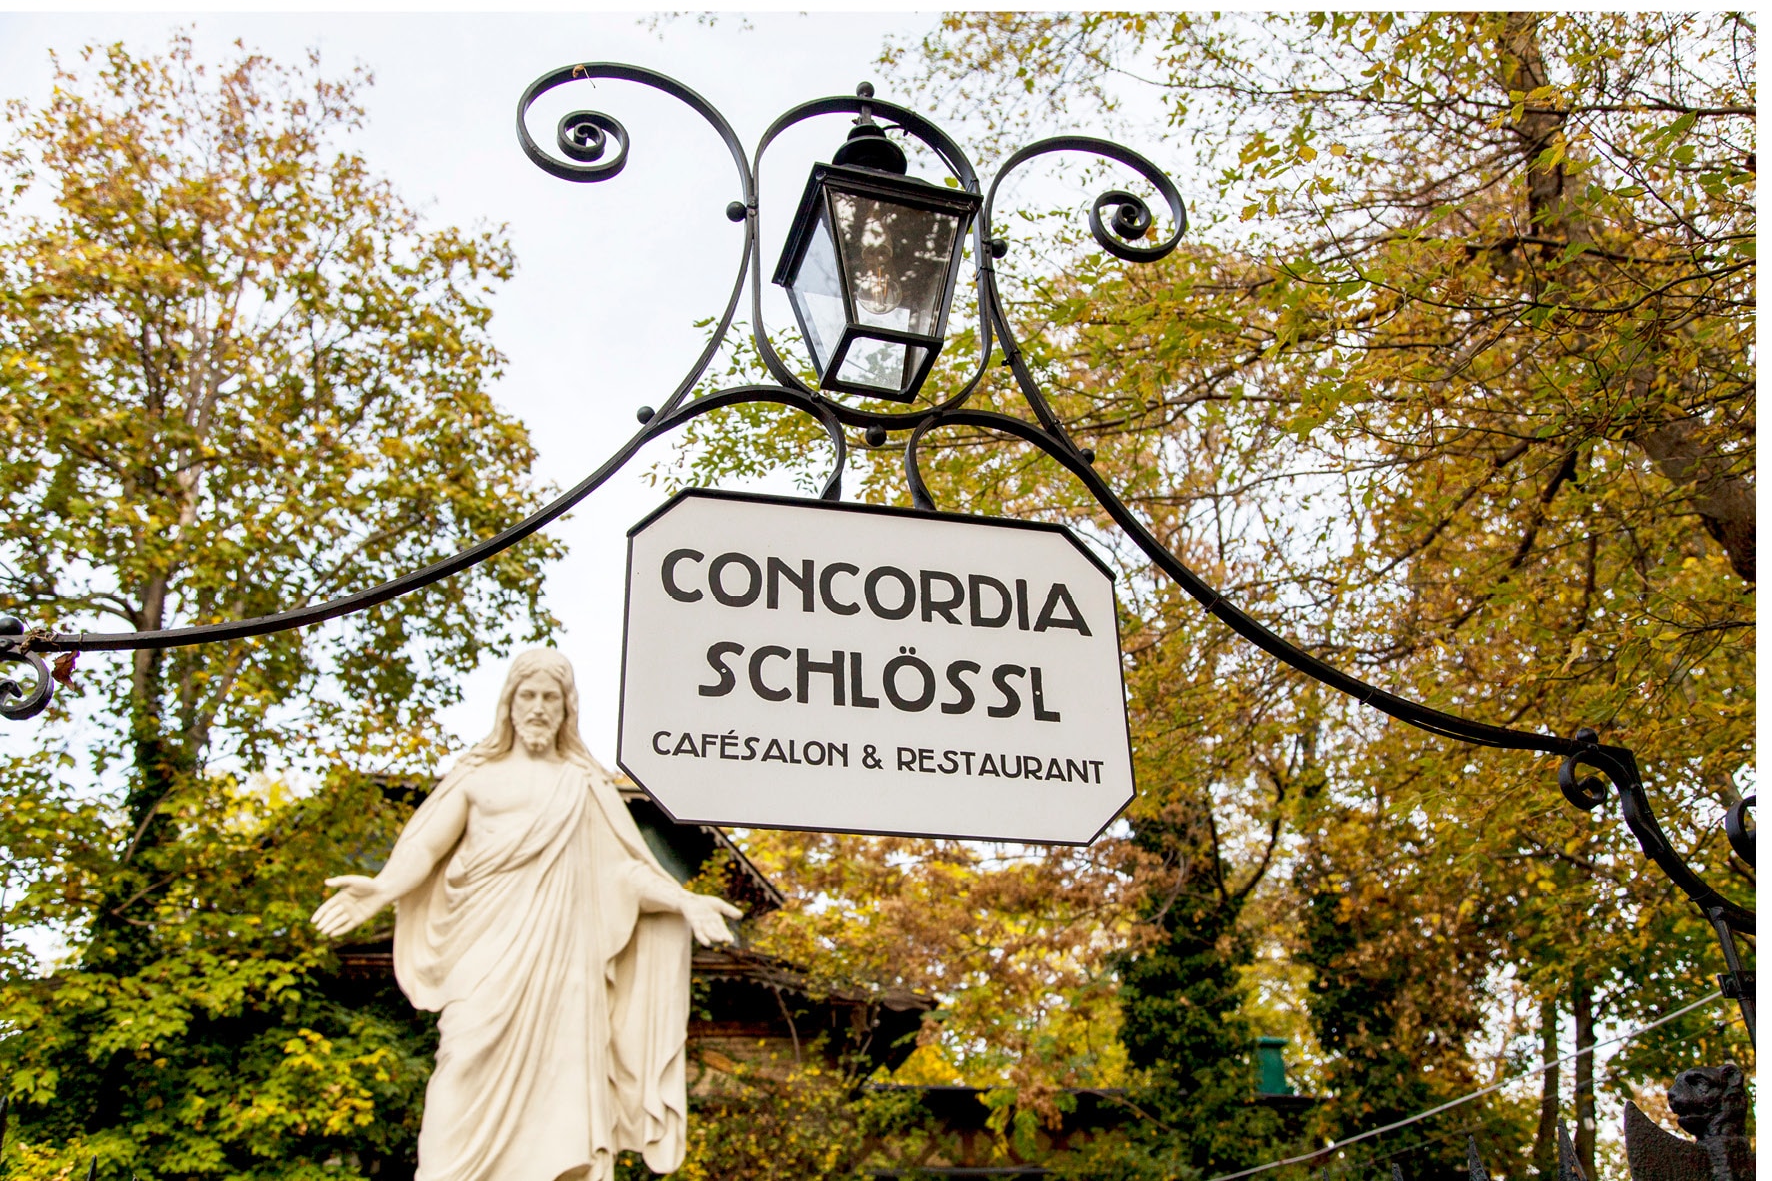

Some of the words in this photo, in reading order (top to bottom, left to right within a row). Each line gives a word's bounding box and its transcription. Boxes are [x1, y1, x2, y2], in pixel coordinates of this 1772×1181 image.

[660, 548, 1093, 637] CONCORDIA
[698, 641, 1061, 723] SCHLÖSSL
[652, 730, 850, 768] CAFÉSALON
[861, 744, 884, 770] &
[897, 746, 1105, 785] RESTAURANT
